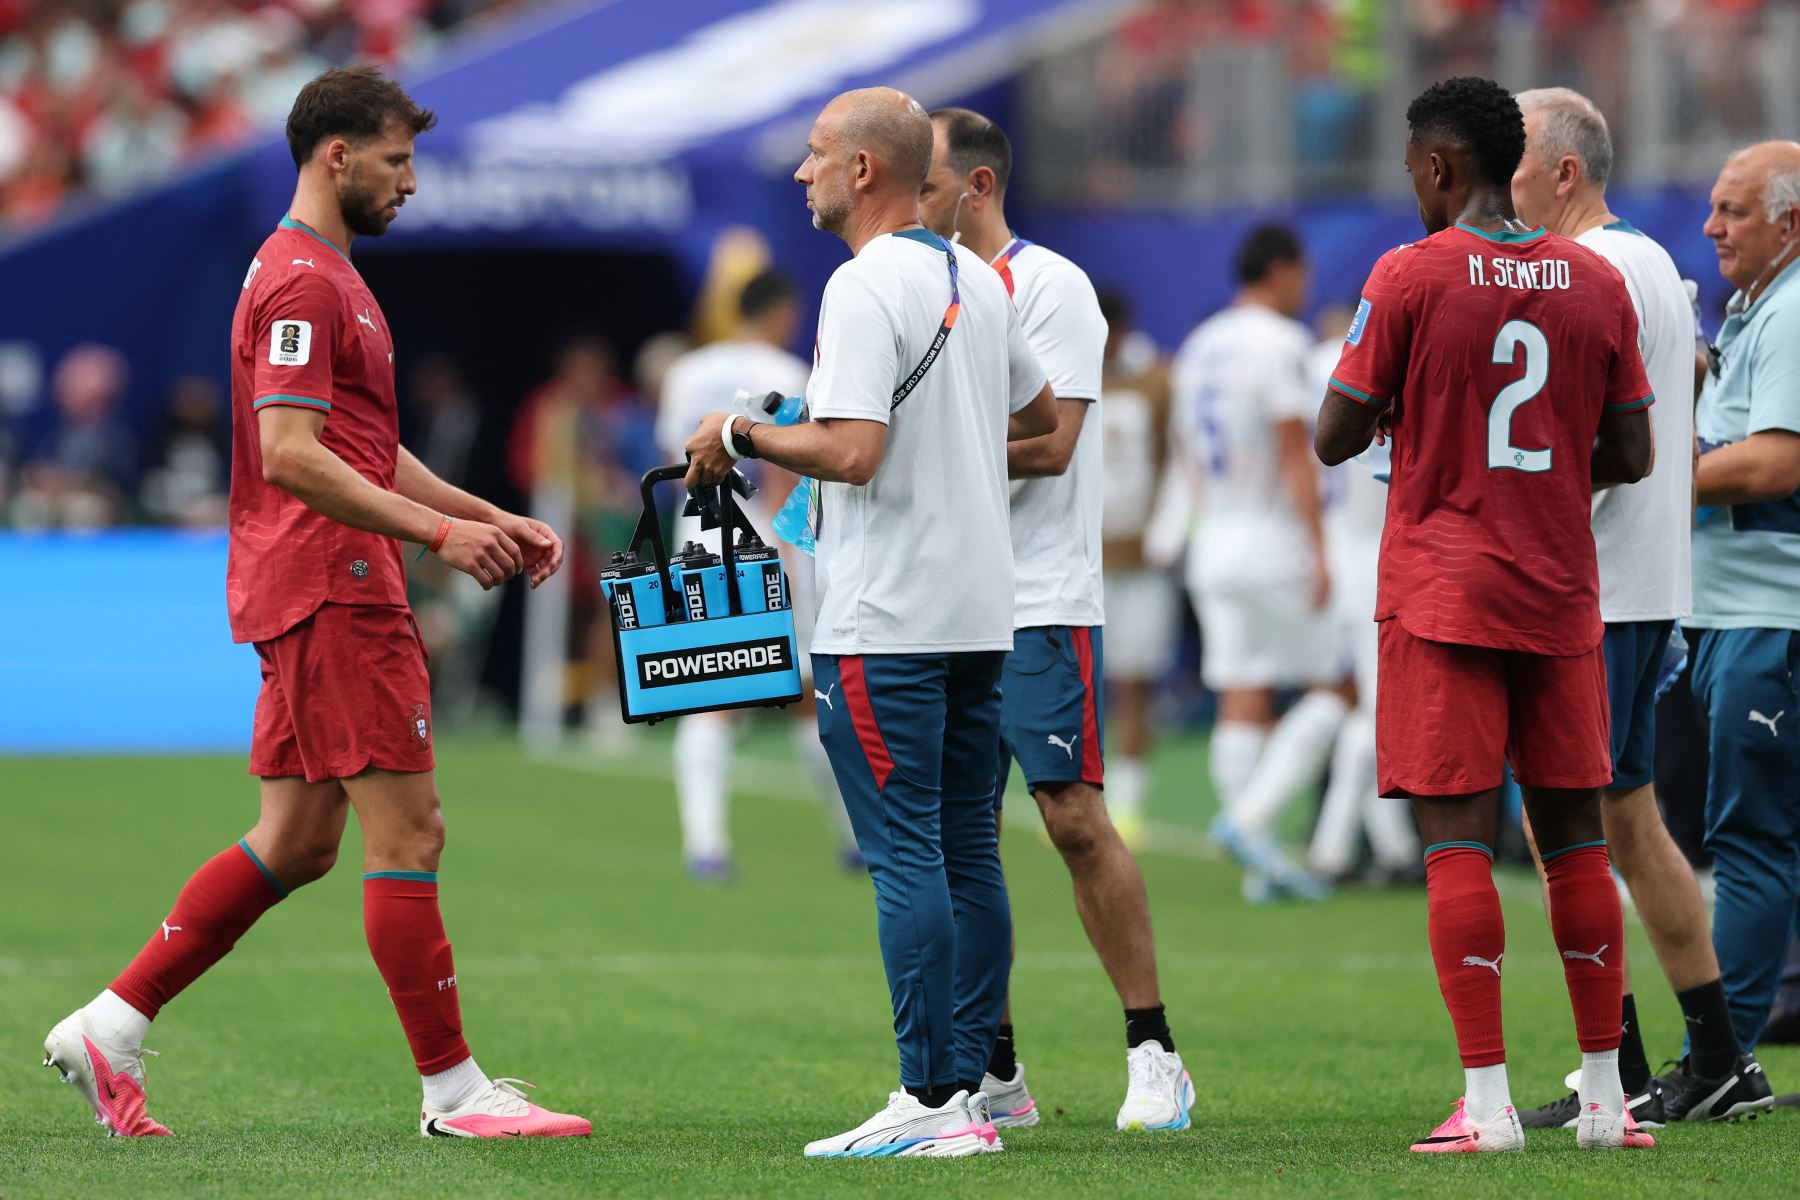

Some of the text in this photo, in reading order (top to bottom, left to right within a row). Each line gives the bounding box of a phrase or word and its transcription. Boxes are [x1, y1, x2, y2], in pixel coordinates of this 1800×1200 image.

[891, 332, 945, 406] FIFA WORLD CUP 20
[1488, 319, 1552, 472] 2
[649, 581, 659, 590] 20
[737, 570, 745, 578] 24
[644, 644, 783, 682] POWERADE
[437, 975, 457, 991] F.P.
